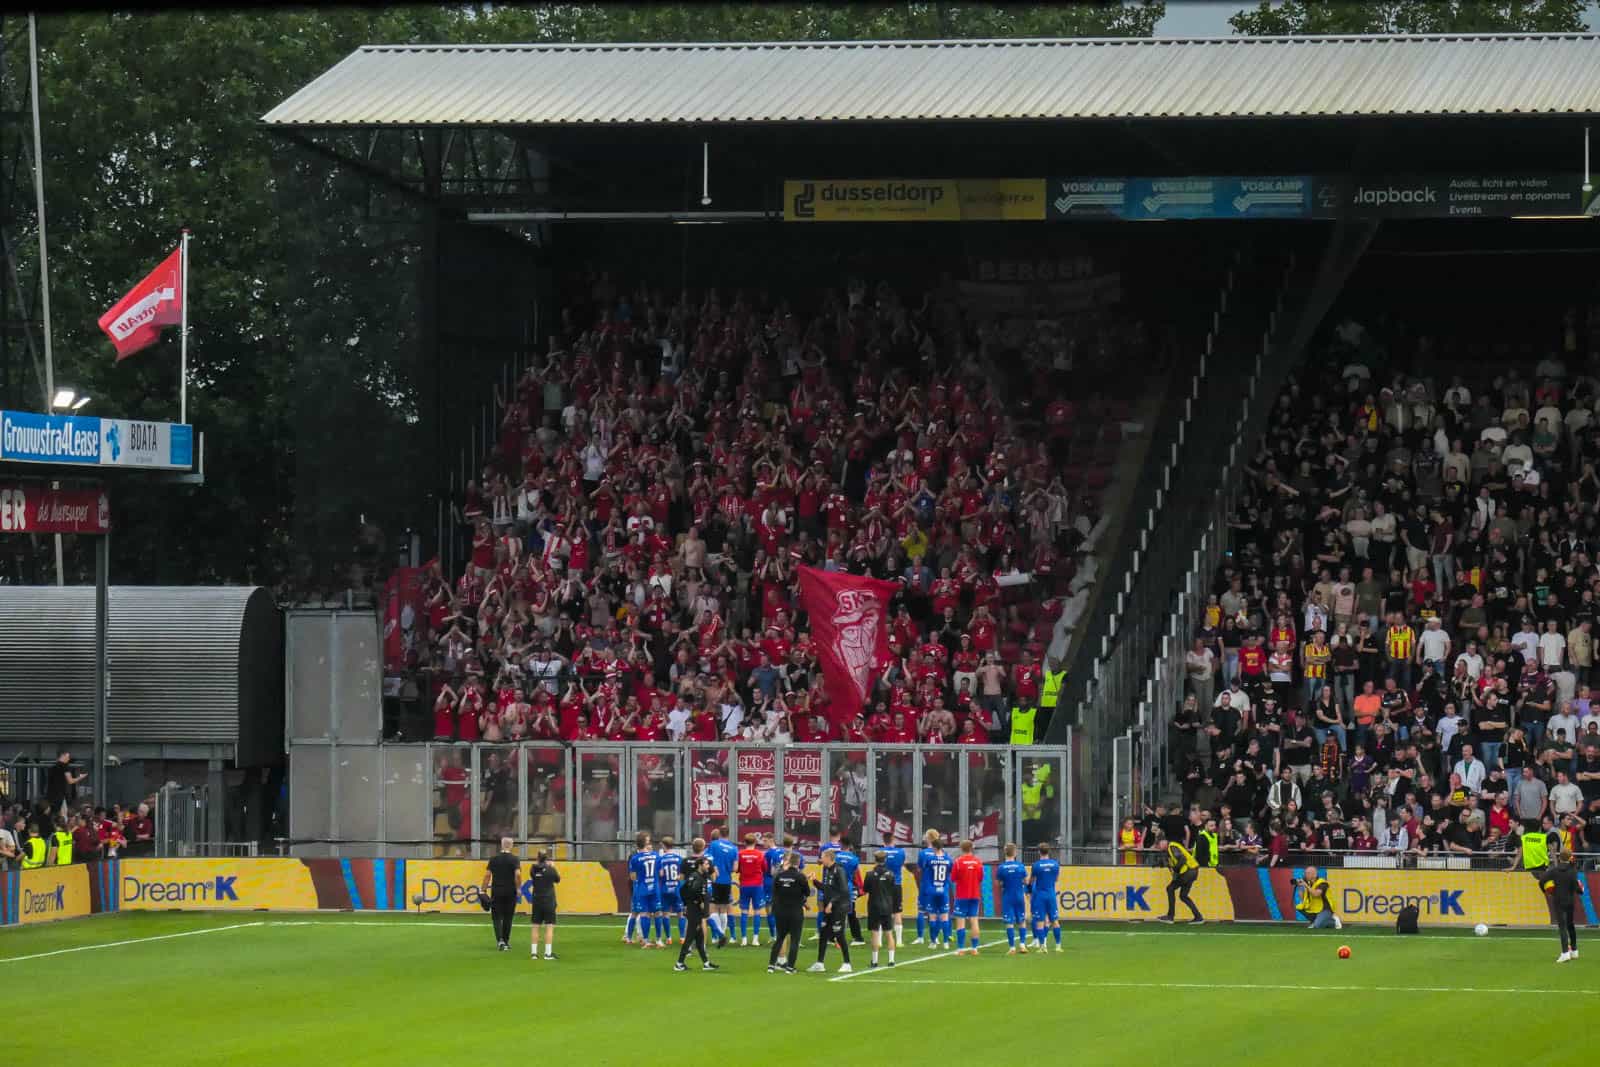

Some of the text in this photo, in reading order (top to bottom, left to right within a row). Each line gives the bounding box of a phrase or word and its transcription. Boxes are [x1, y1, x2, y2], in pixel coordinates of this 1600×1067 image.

[821, 183, 944, 205] dusseldorp
[1062, 182, 1125, 193] VOSKAMP
[1152, 181, 1213, 192] VOSKAMP
[1241, 180, 1303, 192] VOSKAMP
[131, 423, 157, 451] BDATA
[0, 489, 26, 530] ER
[643, 860, 656, 877] 17
[664, 864, 678, 881] 16
[932, 865, 947, 882] 18
